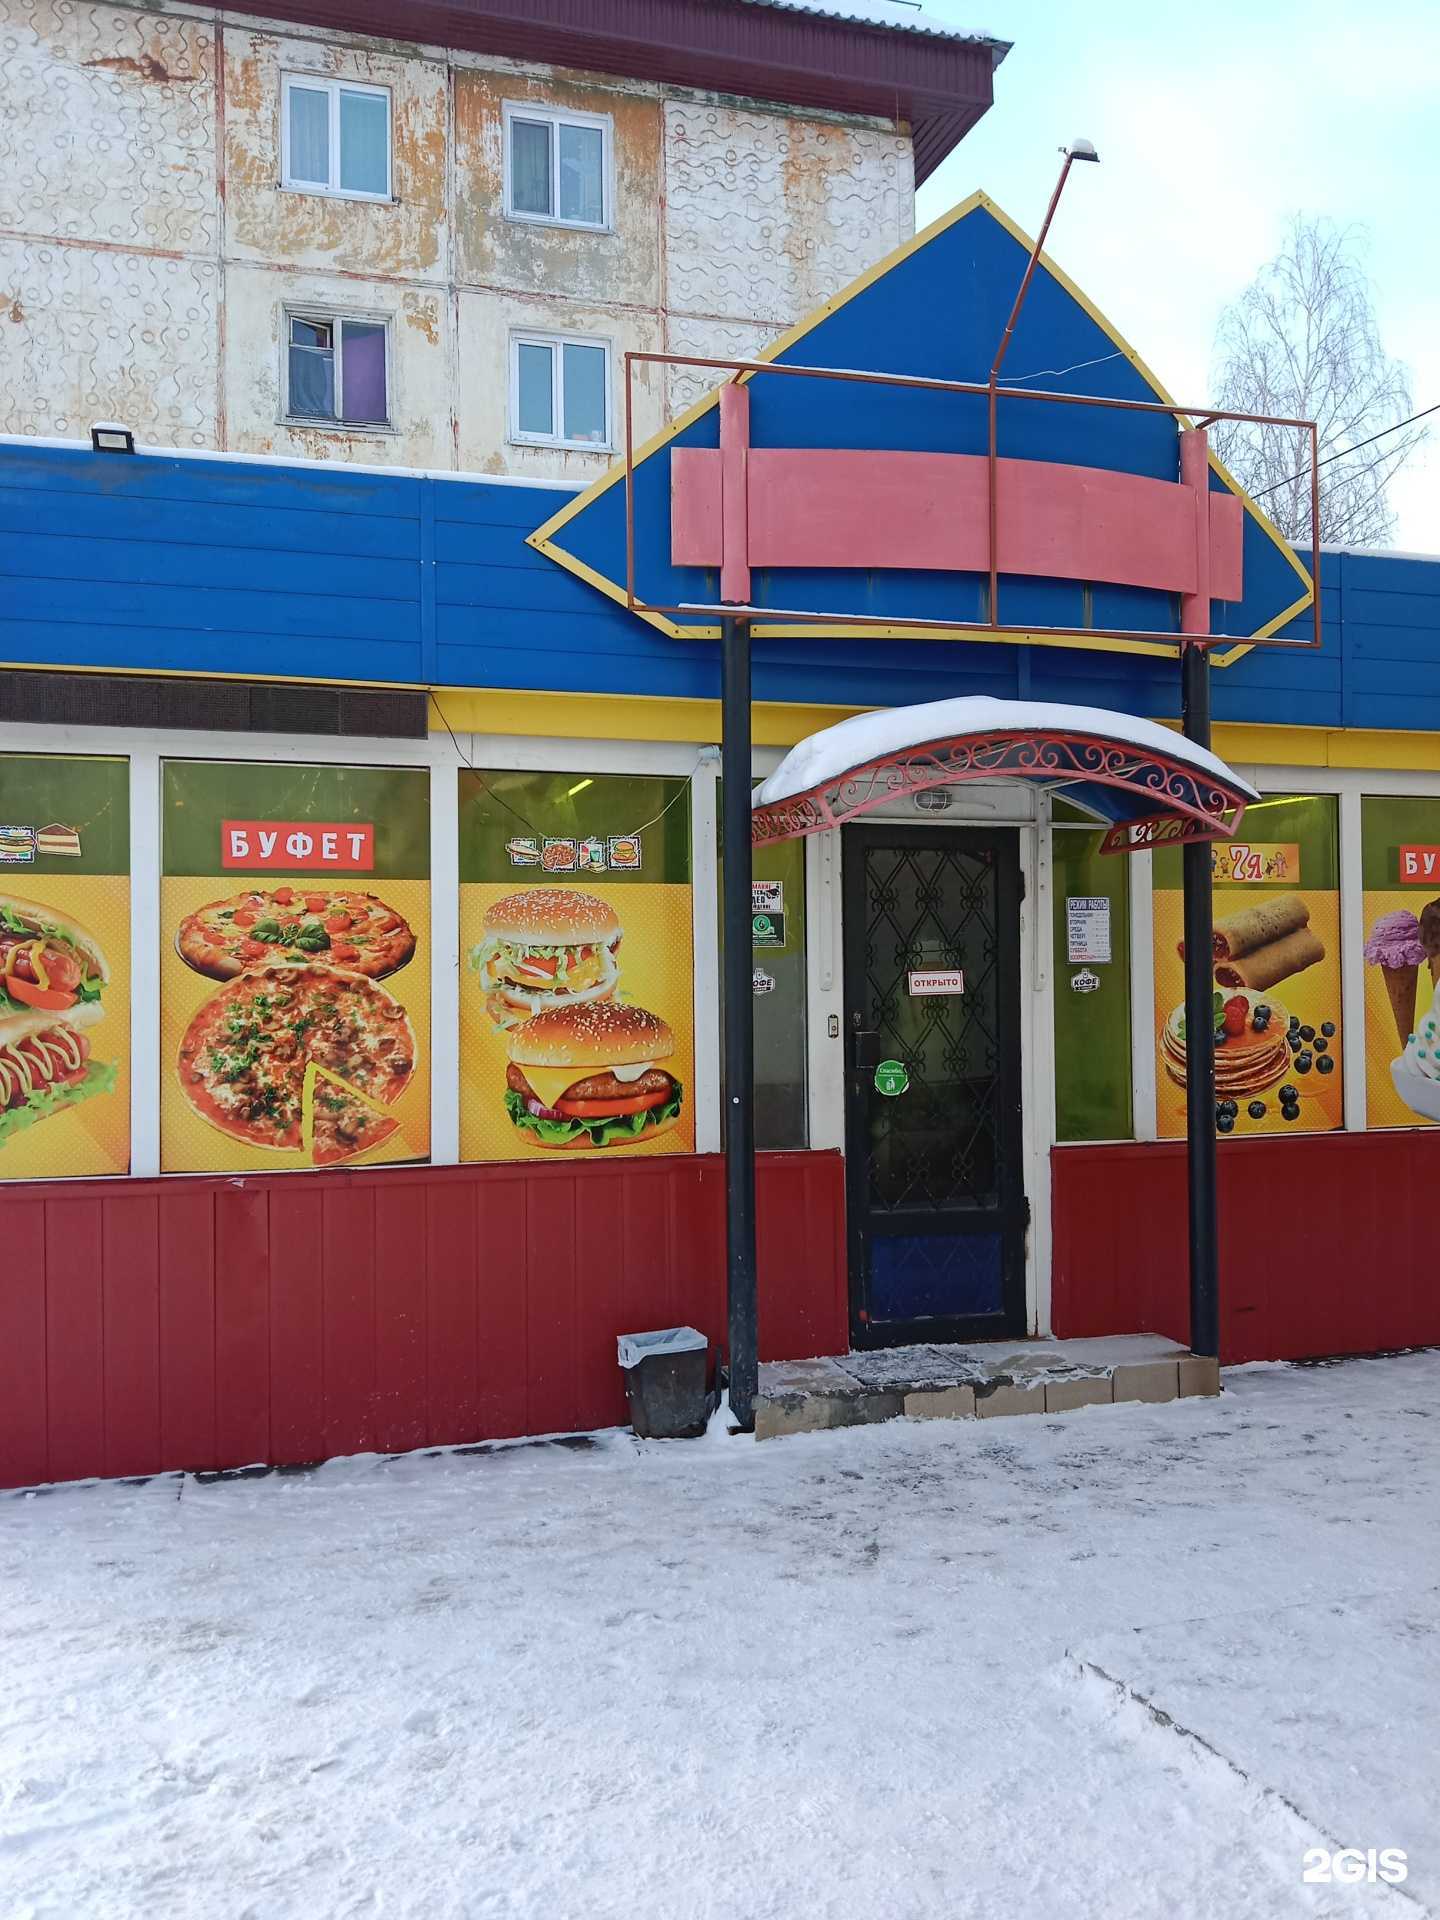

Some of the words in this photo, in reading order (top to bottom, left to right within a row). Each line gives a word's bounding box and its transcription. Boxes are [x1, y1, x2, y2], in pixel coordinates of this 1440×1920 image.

[230, 830, 365, 860] БУФЕТ
[752, 978, 772, 987] ОФЕ
[914, 979, 958, 987] ОТКРЫТО
[1074, 977, 1097, 986] КОФЕ
